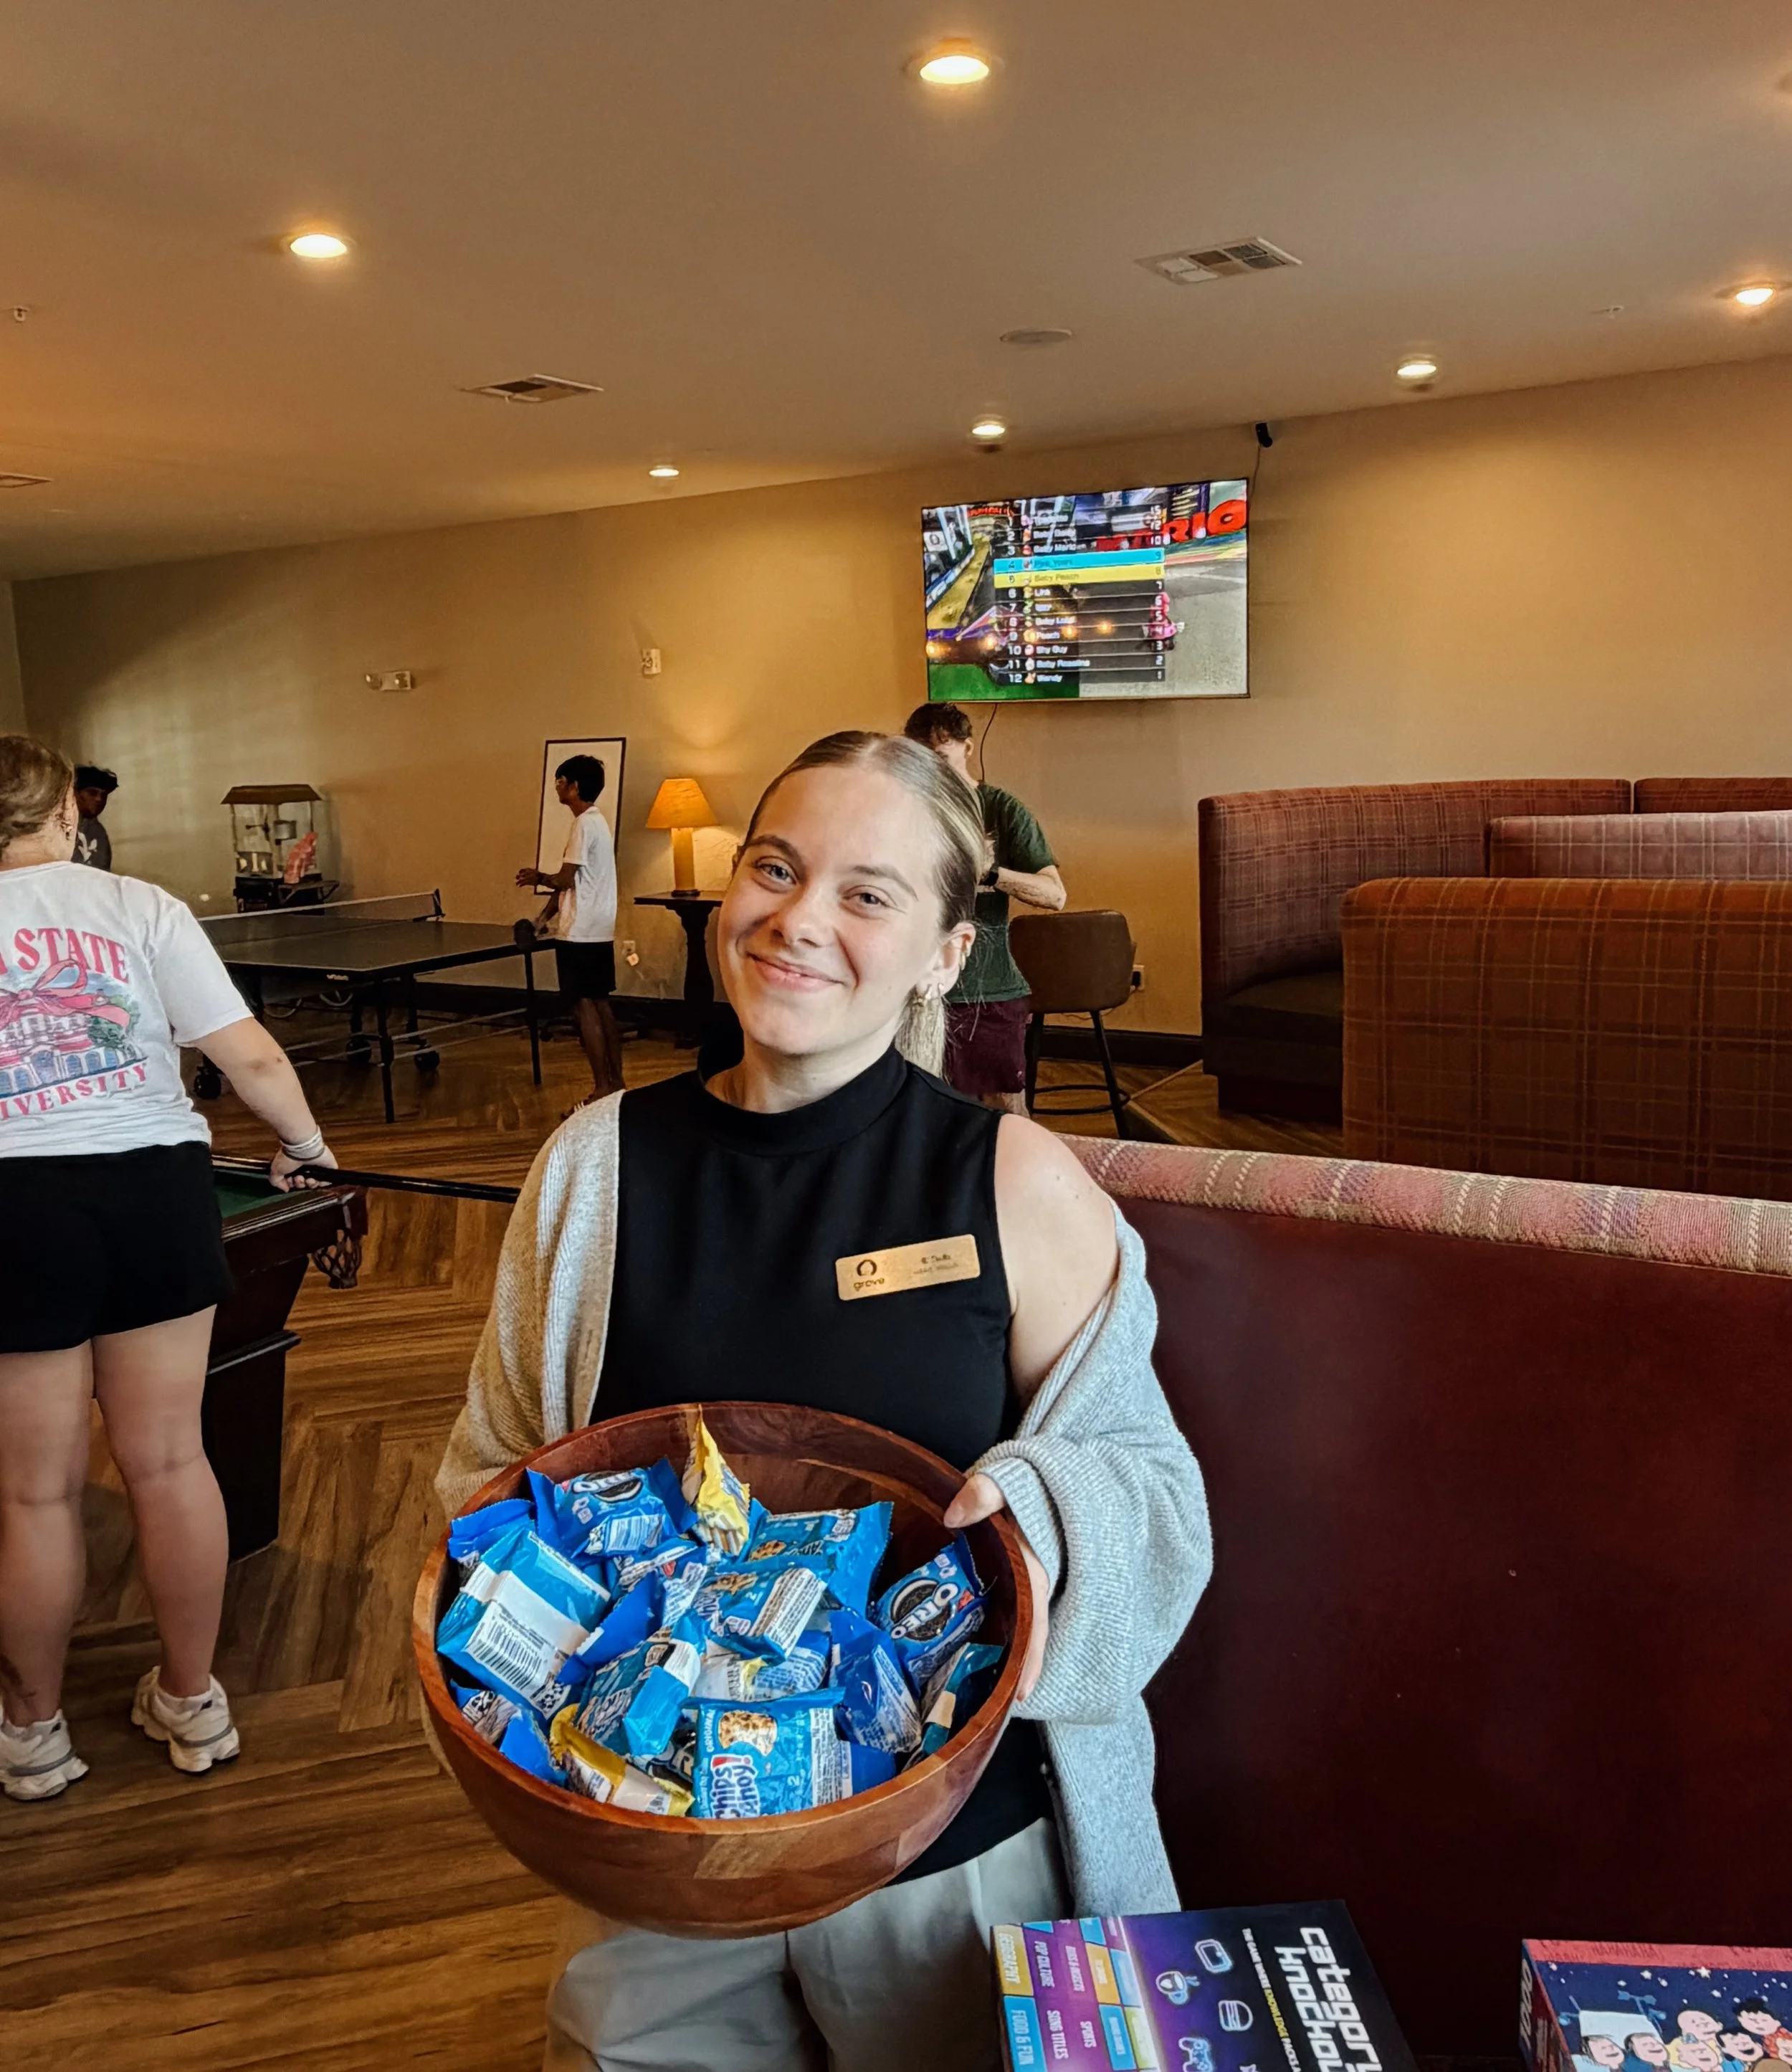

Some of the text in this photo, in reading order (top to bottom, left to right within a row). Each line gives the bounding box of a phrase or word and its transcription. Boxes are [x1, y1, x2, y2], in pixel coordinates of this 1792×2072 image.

[1007, 531, 1015, 541] 2
[1007, 546, 1015, 556] 3
[1009, 603, 1016, 612] 7
[1008, 646, 1021, 656] 10
[1156, 641, 1163, 650] 3
[1008, 660, 1020, 670] 11
[1155, 656, 1163, 665] 2
[1009, 674, 1022, 683] 12
[14, 928, 129, 983] STATE
[853, 1278, 885, 1291] grove
[890, 1582, 960, 1640] OREO
[1036, 1955, 1055, 1987] CULTURE
[1247, 1942, 1262, 1963] GAME
[1264, 1988, 1289, 2038] KNOWLEDGE
[1281, 2038, 1300, 2066] PACKS
[1011, 2010, 1029, 2034] FOOD
[1047, 2010, 1069, 2060] SONG TITLES
[1080, 2020, 1097, 2048] SPORTS
[1017, 2045, 1034, 2066] FUN
